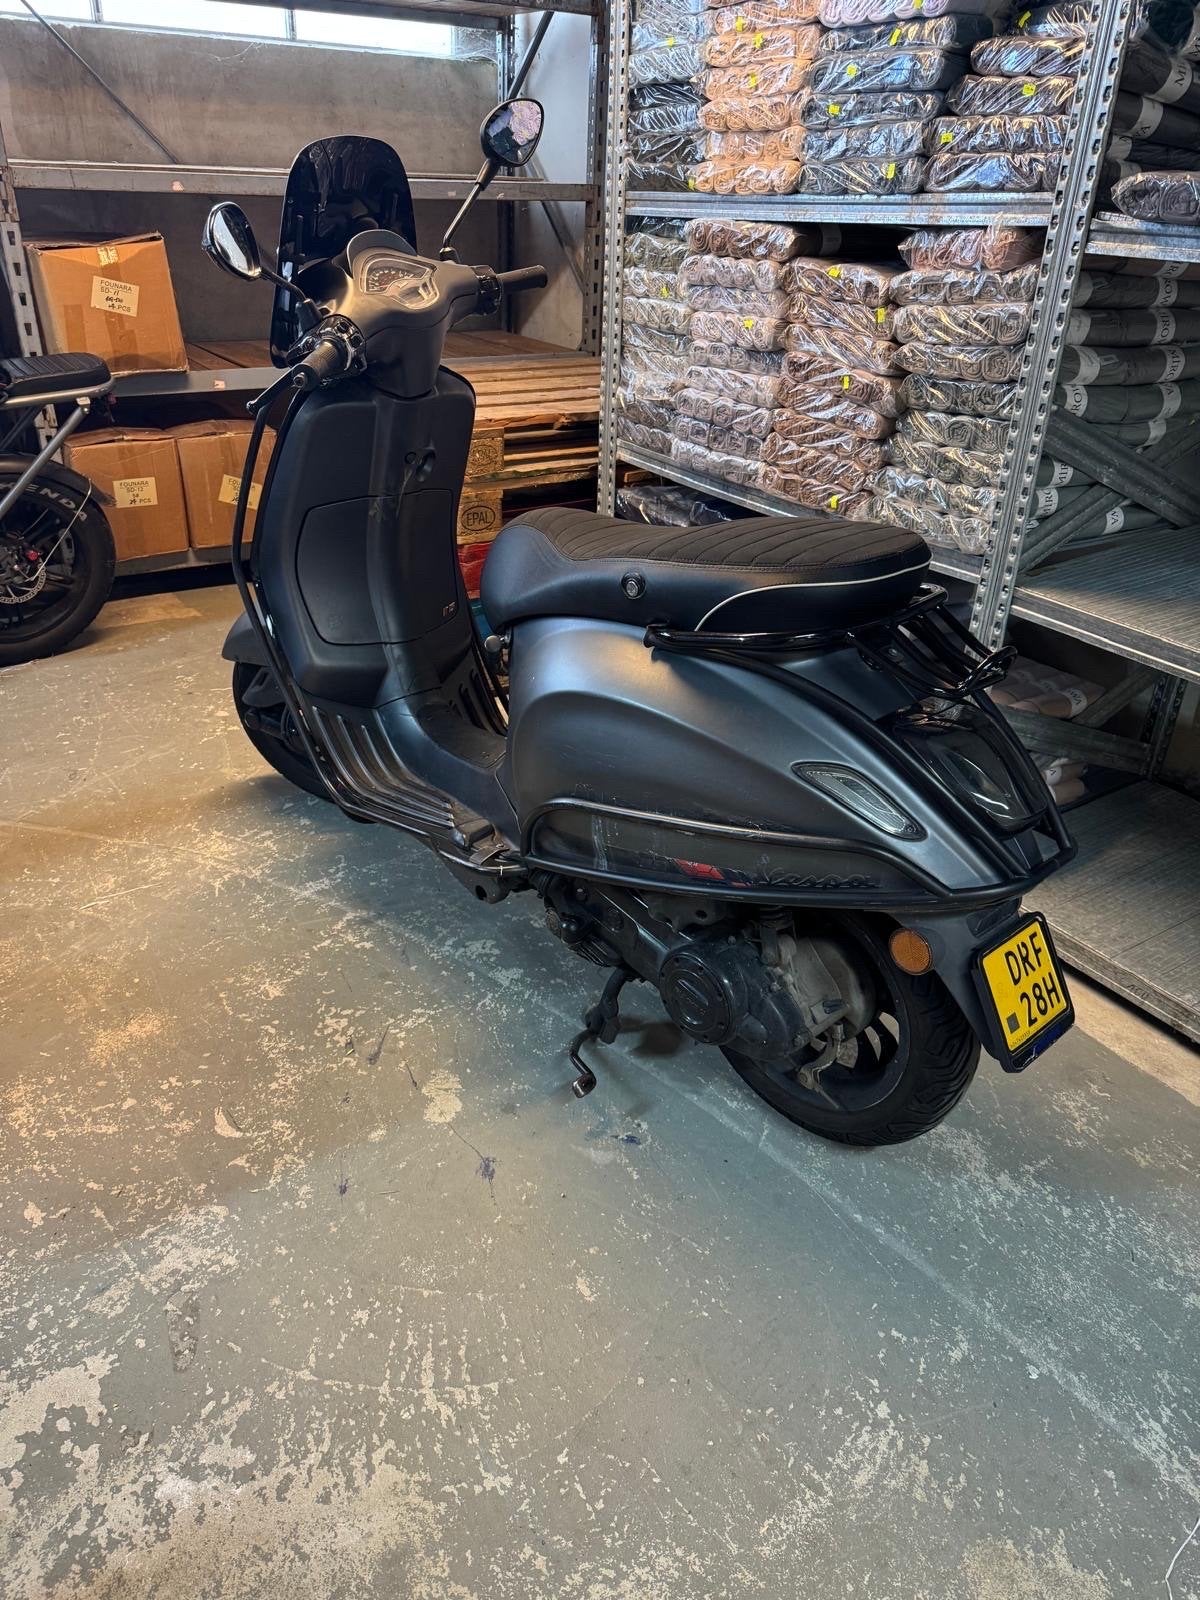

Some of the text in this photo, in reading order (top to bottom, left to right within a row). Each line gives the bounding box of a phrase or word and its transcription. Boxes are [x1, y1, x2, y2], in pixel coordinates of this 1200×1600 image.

[466, 512, 491, 527] EPAL
[1004, 932, 1042, 986] DRF
[1020, 972, 1061, 1027] 28H
